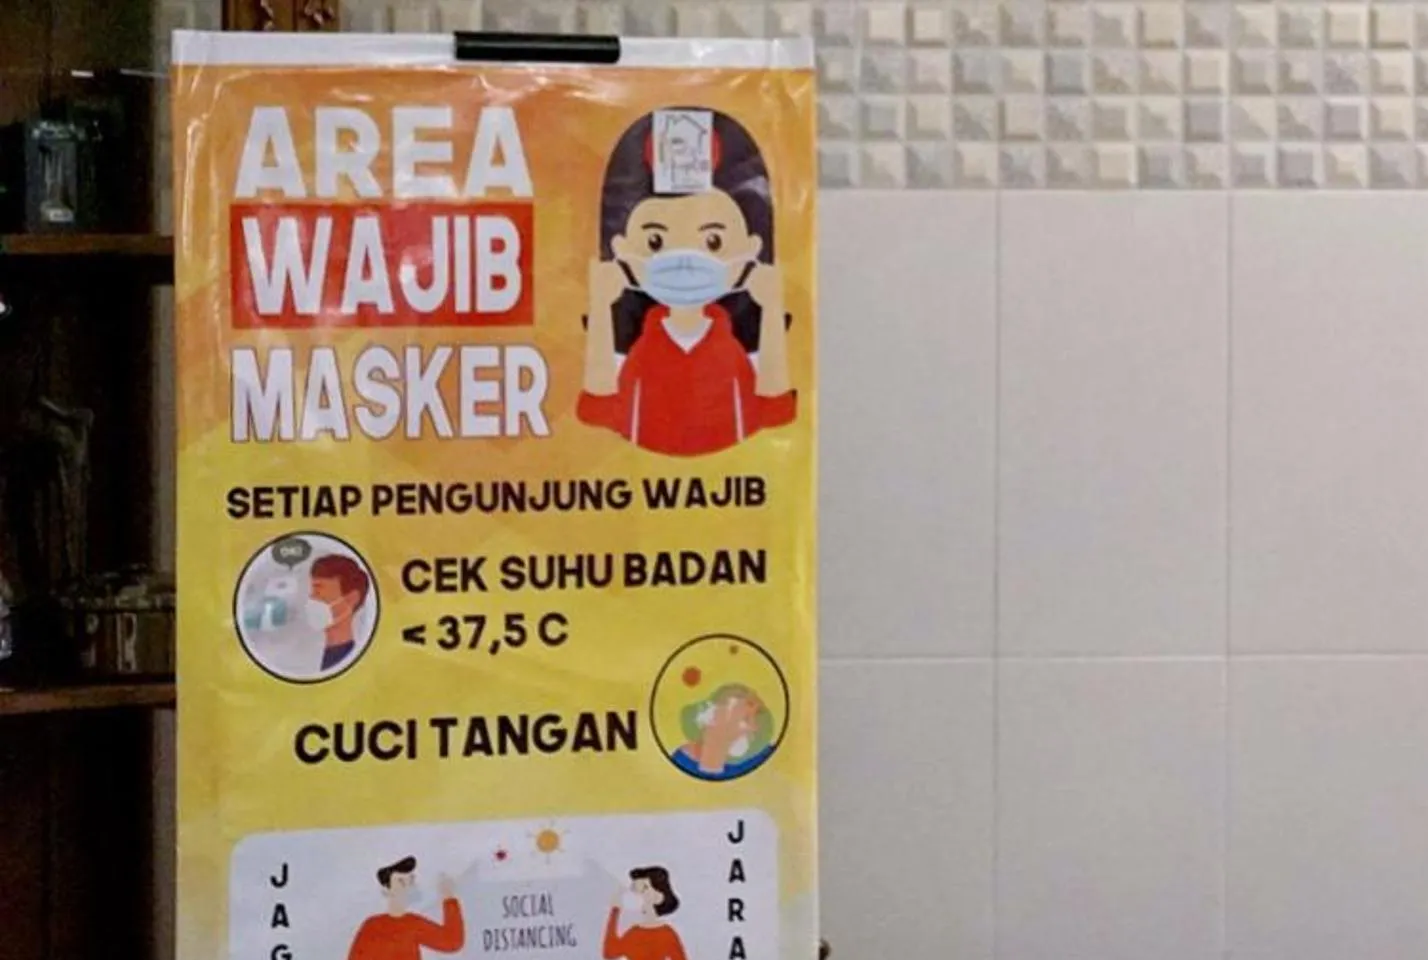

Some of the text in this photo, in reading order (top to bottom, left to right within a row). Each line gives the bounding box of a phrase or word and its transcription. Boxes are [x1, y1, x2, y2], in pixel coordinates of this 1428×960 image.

[234, 105, 533, 199] AREA
[242, 215, 522, 314] WAJIB
[230, 344, 550, 443] MASKER
[225, 476, 767, 519] SETIAP PENGUNJUNG WAJIB
[401, 550, 768, 594] CEK SUHU BADAN
[437, 614, 528, 655] 37,5
[538, 612, 569, 647] C
[294, 710, 639, 765] CUCI TANGAN
[502, 893, 555, 918] SOCIAL
[483, 923, 578, 952] DISTANCING
